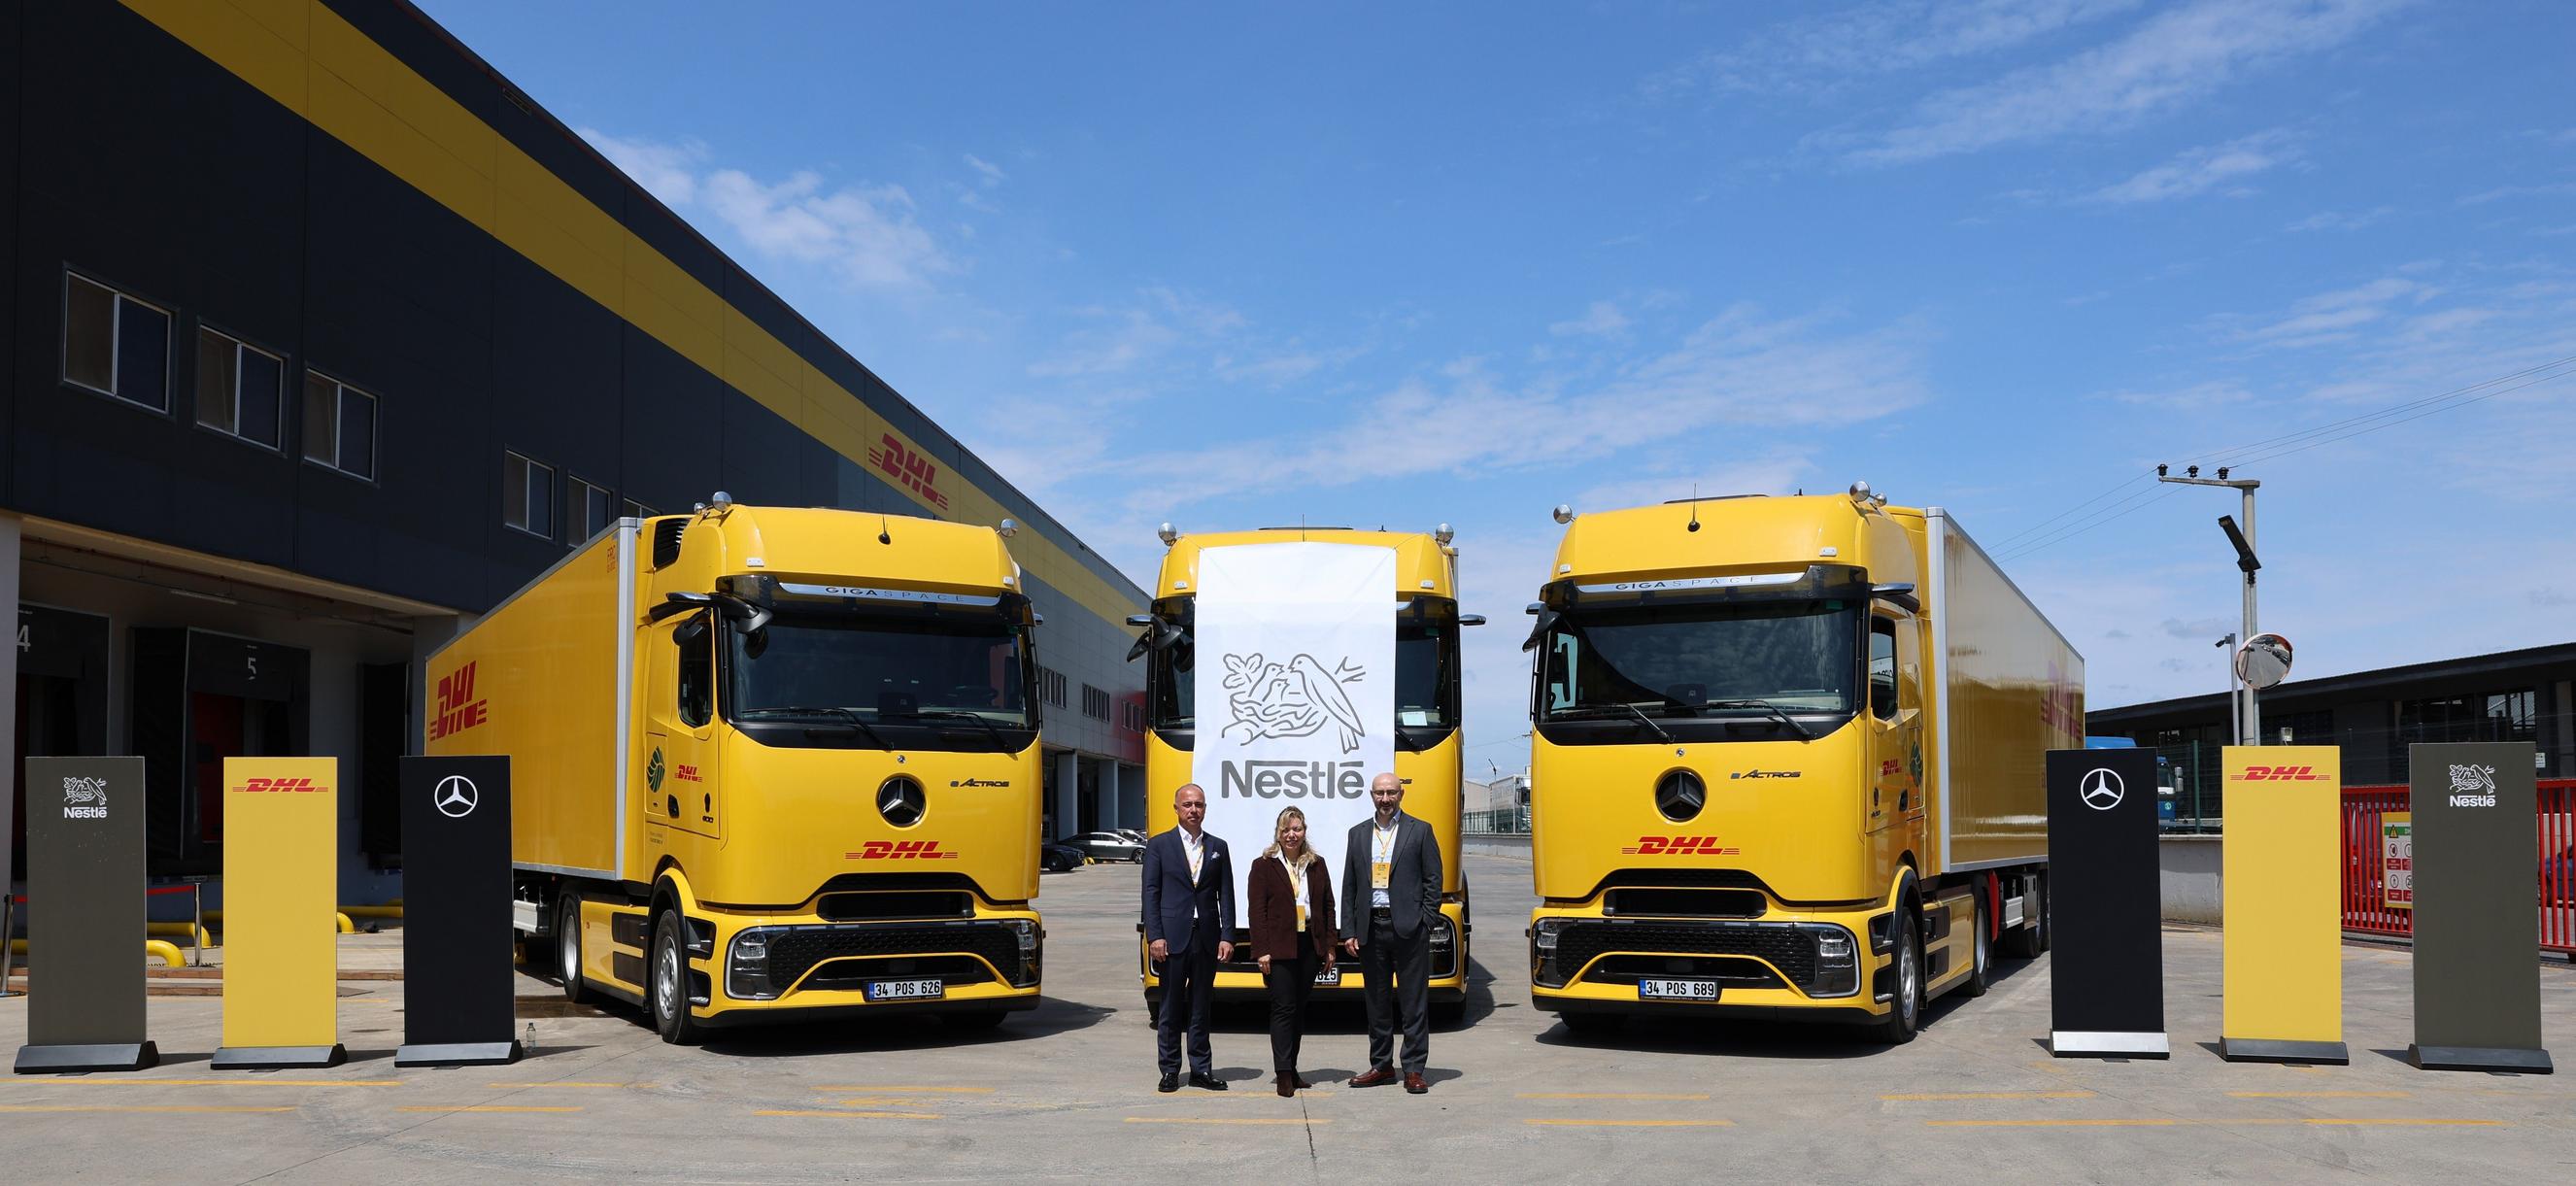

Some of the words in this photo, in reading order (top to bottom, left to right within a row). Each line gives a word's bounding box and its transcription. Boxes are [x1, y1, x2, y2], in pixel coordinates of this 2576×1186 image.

[881, 432, 938, 503] DHL
[17, 625, 31, 653] 4
[248, 657, 256, 681] 5
[437, 660, 479, 739] DHL
[678, 764, 698, 782] DHL
[1882, 759, 1901, 777] DHL
[2244, 766, 2317, 781] DHL
[246, 778, 317, 793] DHL
[1221, 760, 1365, 799] Nestlé
[2449, 795, 2496, 807] Nestlé
[63, 806, 108, 819] Nestlé
[861, 841, 943, 860] DHL
[1637, 836, 1723, 855] DHL
[875, 983, 888, 997] 34
[895, 982, 915, 996] POS
[921, 981, 940, 995] 626
[1646, 981, 1659, 995] 34
[1666, 982, 1687, 996] POS
[1693, 983, 1714, 997] 689
